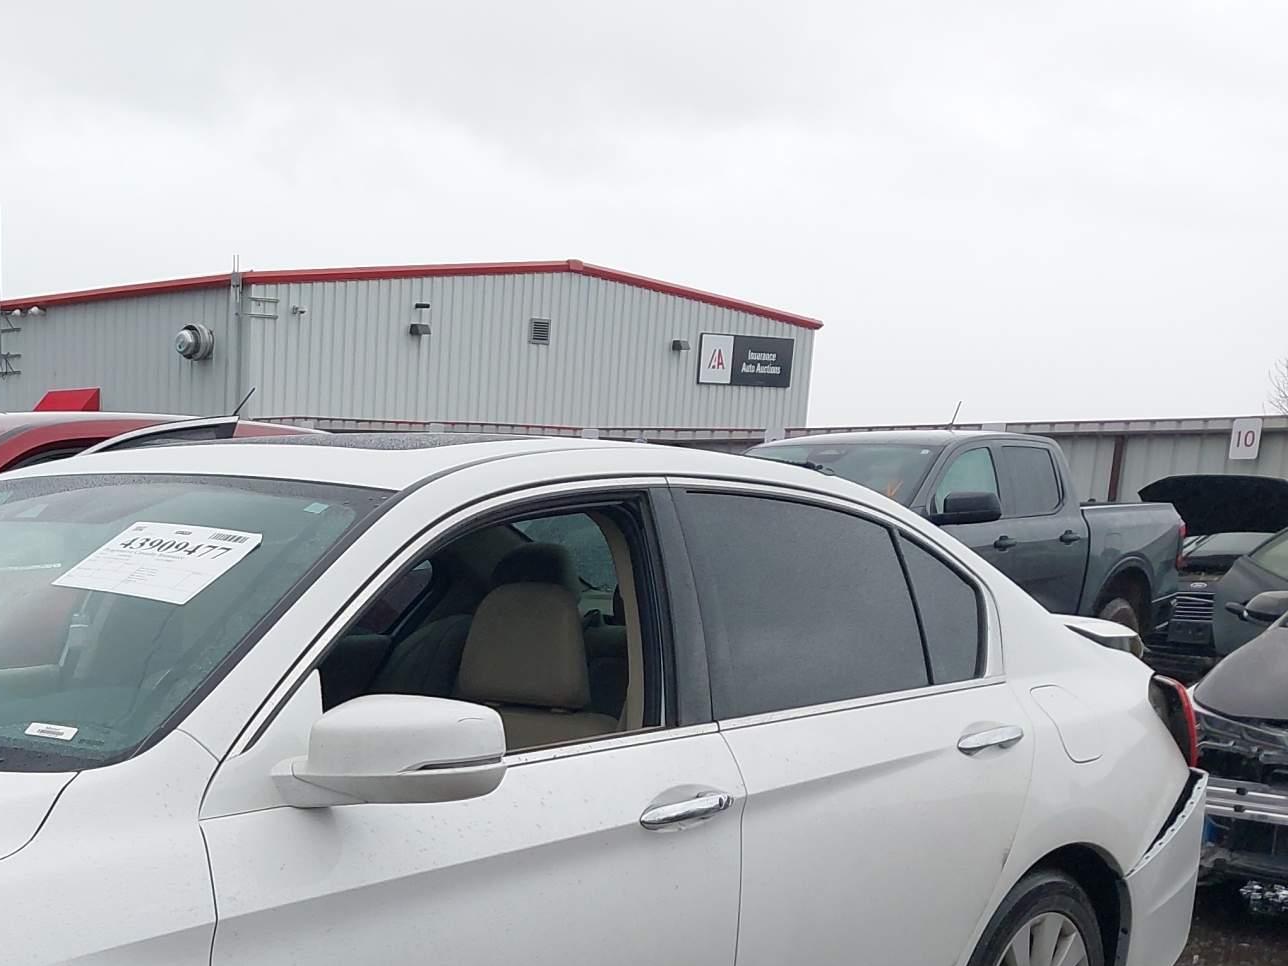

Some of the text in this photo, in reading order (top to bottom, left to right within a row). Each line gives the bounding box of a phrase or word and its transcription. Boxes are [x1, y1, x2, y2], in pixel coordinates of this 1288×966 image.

[748, 350, 776, 361] Insurance
[741, 362, 781, 375] Auto Auctions
[1236, 430, 1255, 448] 10
[120, 536, 233, 560] 43909477
